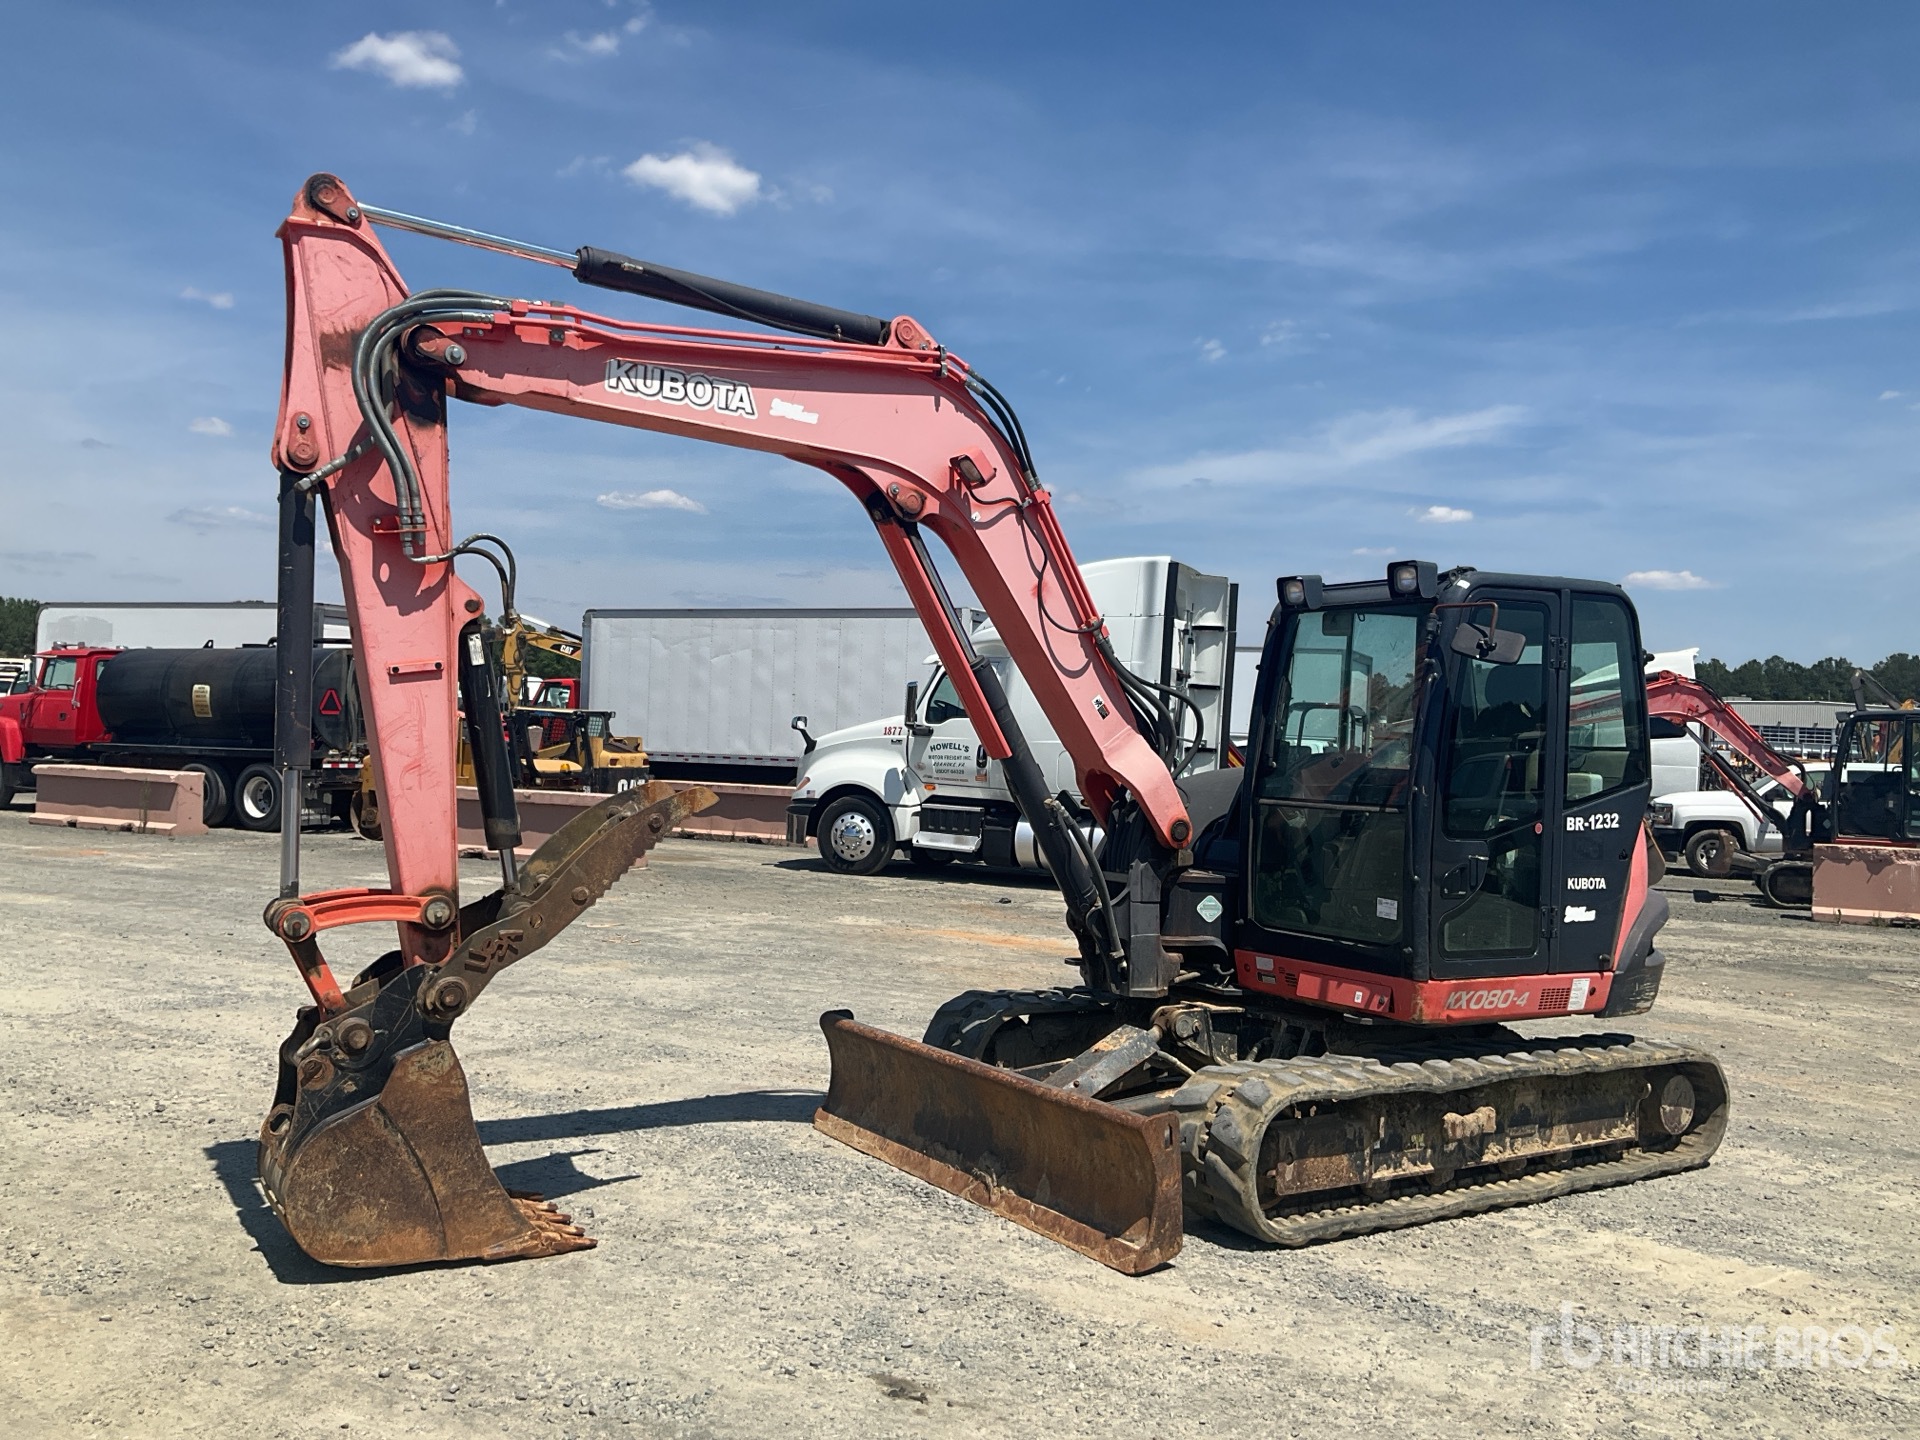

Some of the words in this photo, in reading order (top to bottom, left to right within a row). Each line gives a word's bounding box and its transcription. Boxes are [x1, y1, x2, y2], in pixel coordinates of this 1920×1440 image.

[606, 358, 757, 418] KUBOTA
[560, 644, 574, 655] CAT
[884, 727, 903, 736] 1877
[930, 743, 970, 753] HOWELL'S
[1566, 813, 1620, 831] BR-1232
[1567, 877, 1607, 890] KUBOTA
[1445, 989, 1530, 1010] KX080-4
